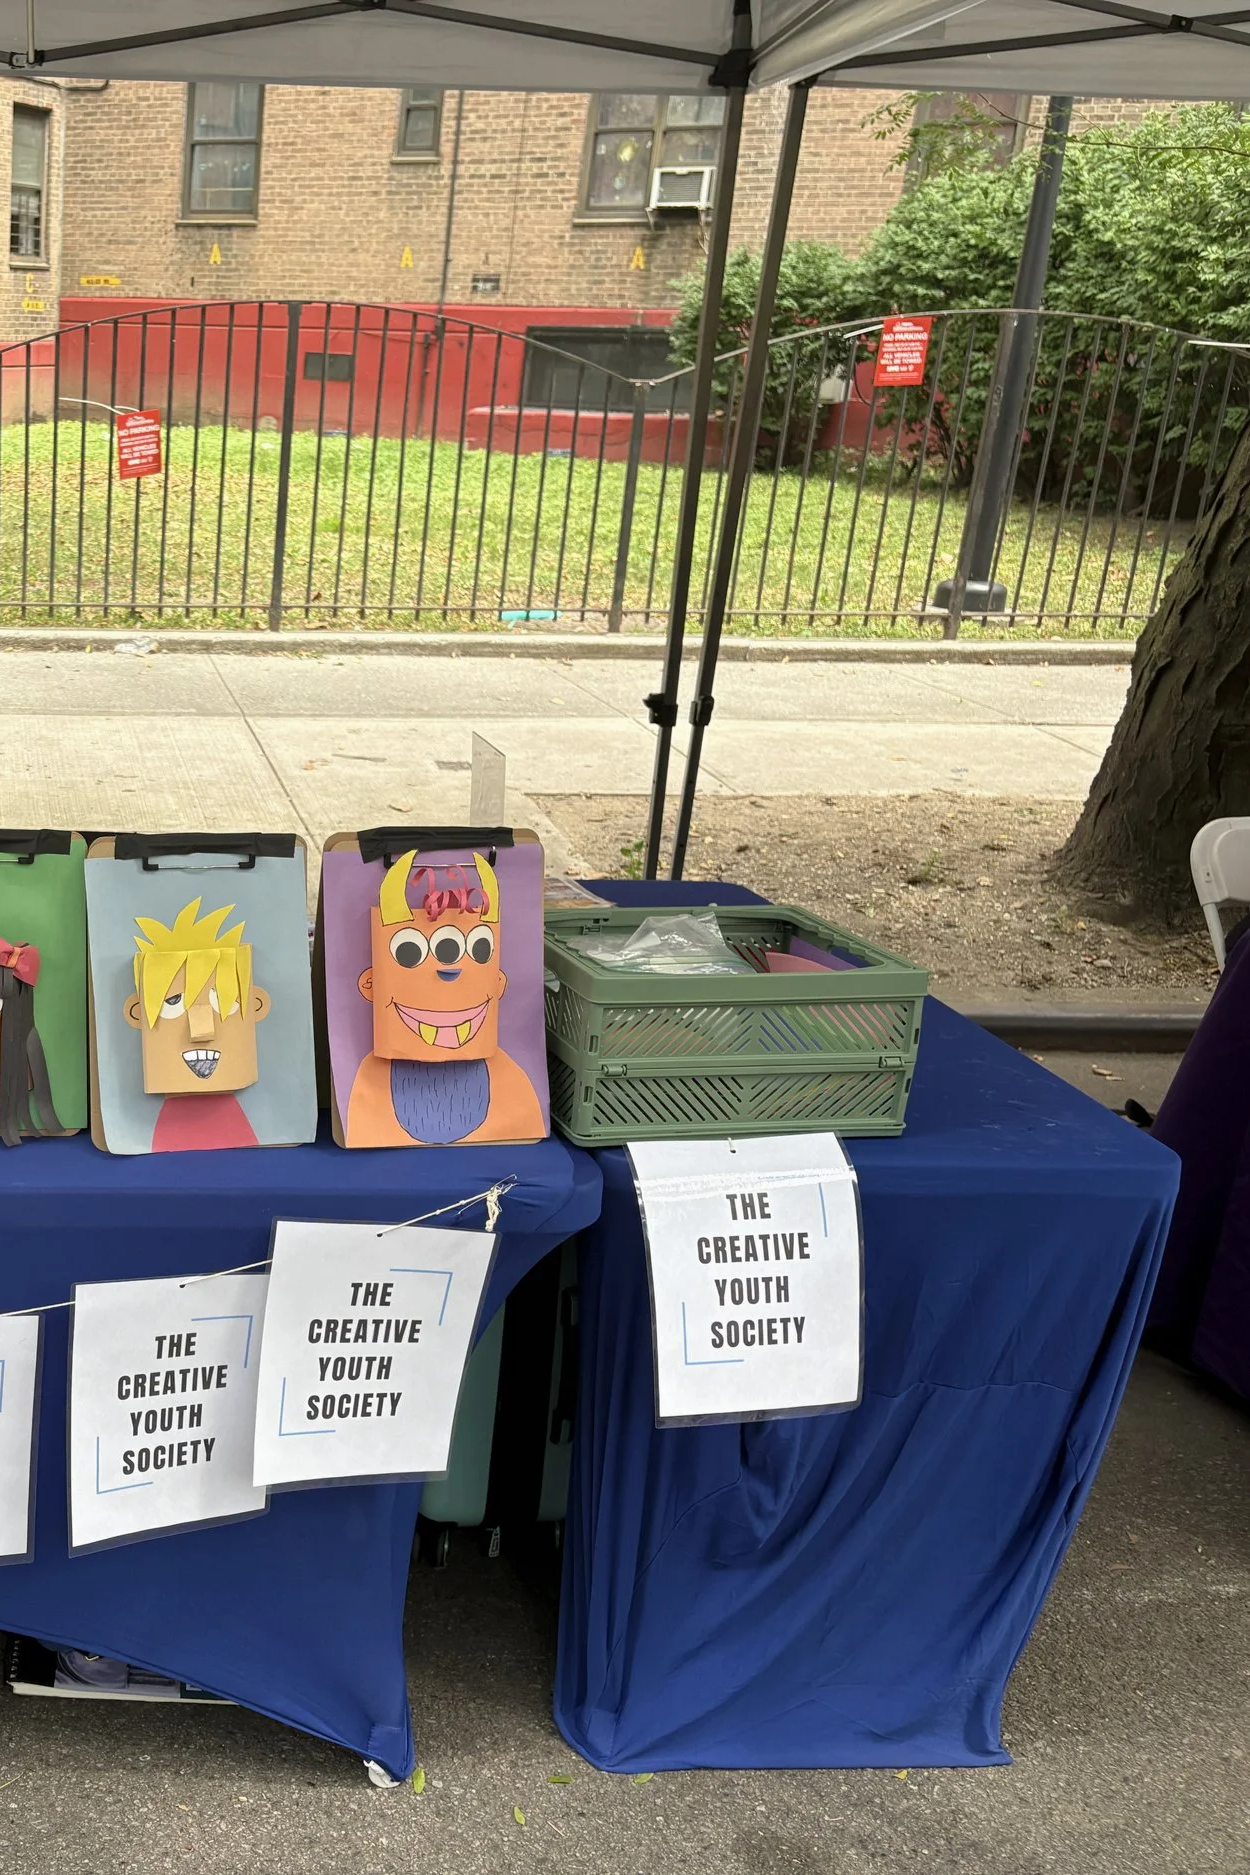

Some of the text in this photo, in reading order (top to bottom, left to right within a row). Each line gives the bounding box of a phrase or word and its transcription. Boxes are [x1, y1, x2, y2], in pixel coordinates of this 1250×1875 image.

[210, 243, 222, 265] A
[399, 245, 414, 268] A
[630, 246, 646, 270] A
[883, 332, 928, 341] NO PARKING
[725, 1192, 771, 1220] THE
[697, 1232, 810, 1264] CREATIVE
[350, 1282, 393, 1306] THE
[714, 1275, 789, 1306] YOUTH
[307, 1318, 422, 1343] CREATIVE
[710, 1316, 805, 1348] SOCIETY
[154, 1332, 196, 1359] THE
[117, 1364, 228, 1400] CREATIVE
[318, 1356, 392, 1381] YOUTH
[129, 1403, 202, 1436] YOUTH
[306, 1392, 402, 1420] SOCIETY
[122, 1437, 215, 1475] SOCIETY
